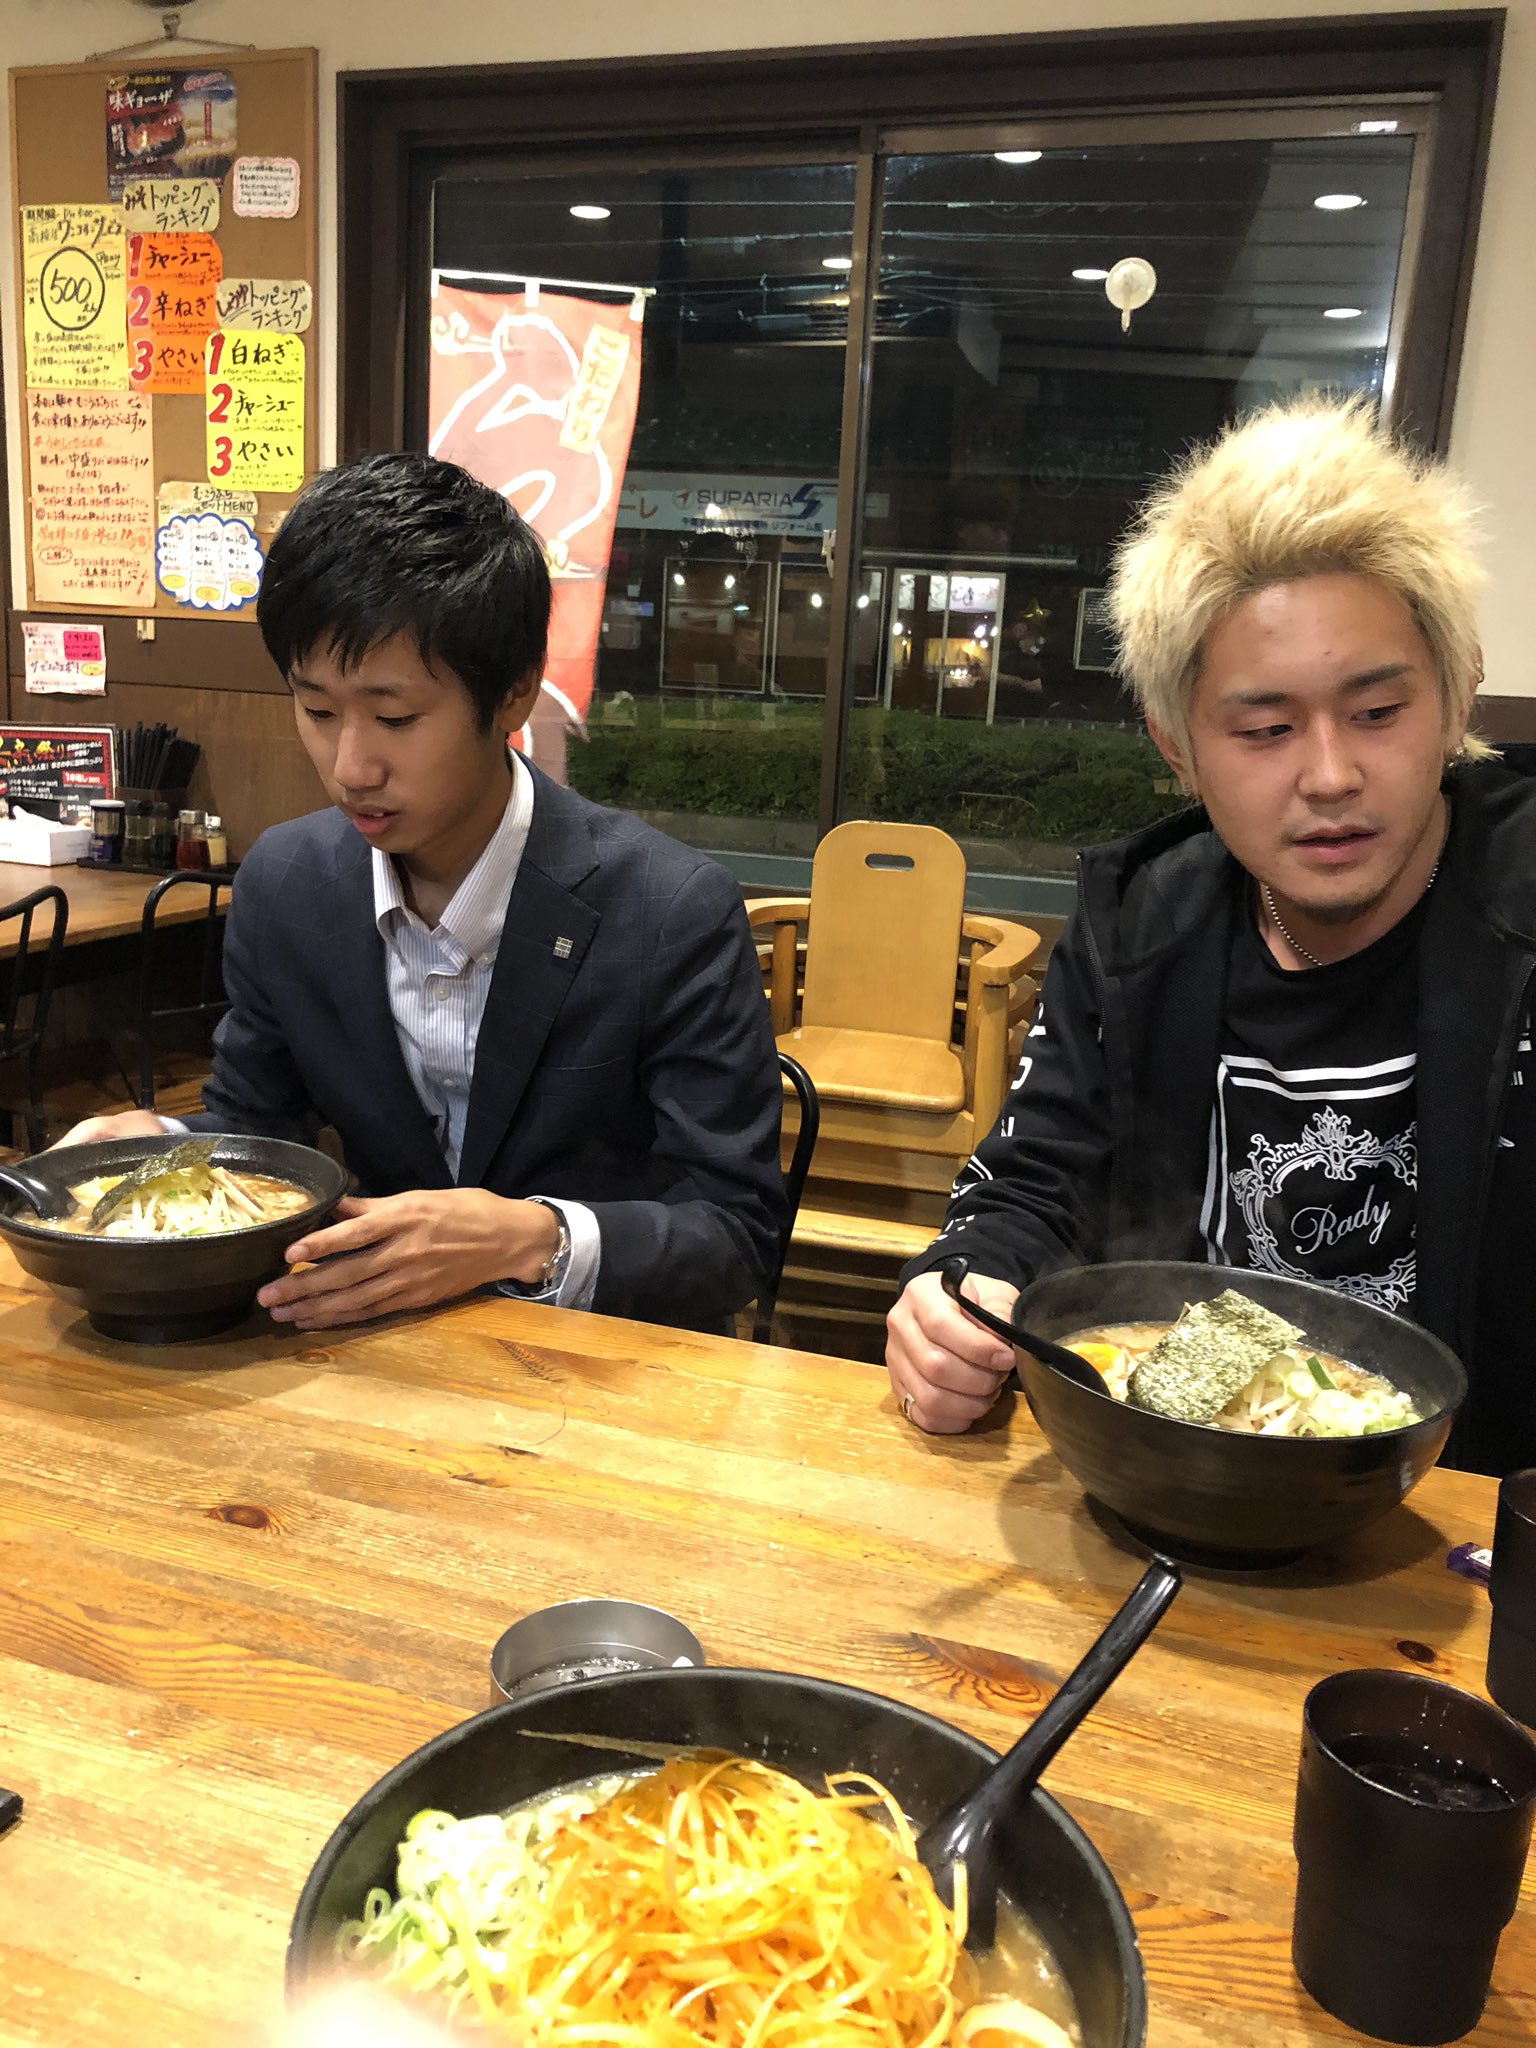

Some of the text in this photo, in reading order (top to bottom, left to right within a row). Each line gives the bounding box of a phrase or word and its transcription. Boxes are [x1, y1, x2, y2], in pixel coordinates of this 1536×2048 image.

[156, 197, 217, 232] ランキング
[129, 235, 144, 278] 1
[145, 245, 211, 270] チャーシュー
[50, 269, 92, 305] 500
[129, 285, 150, 328] 2
[151, 291, 214, 321] 辛ねぎ
[251, 303, 308, 330] ランキング
[131, 341, 153, 380] 3
[158, 348, 205, 368] やさい
[209, 333, 226, 375] 1
[231, 339, 294, 366] 白ねぎ
[208, 383, 233, 424] 2
[234, 389, 296, 416] チャーシュー
[210, 436, 233, 477] 3
[238, 440, 294, 463] やさい
[697, 489, 793, 508] SUPARIA
[1291, 1184, 1391, 1255] Rady
